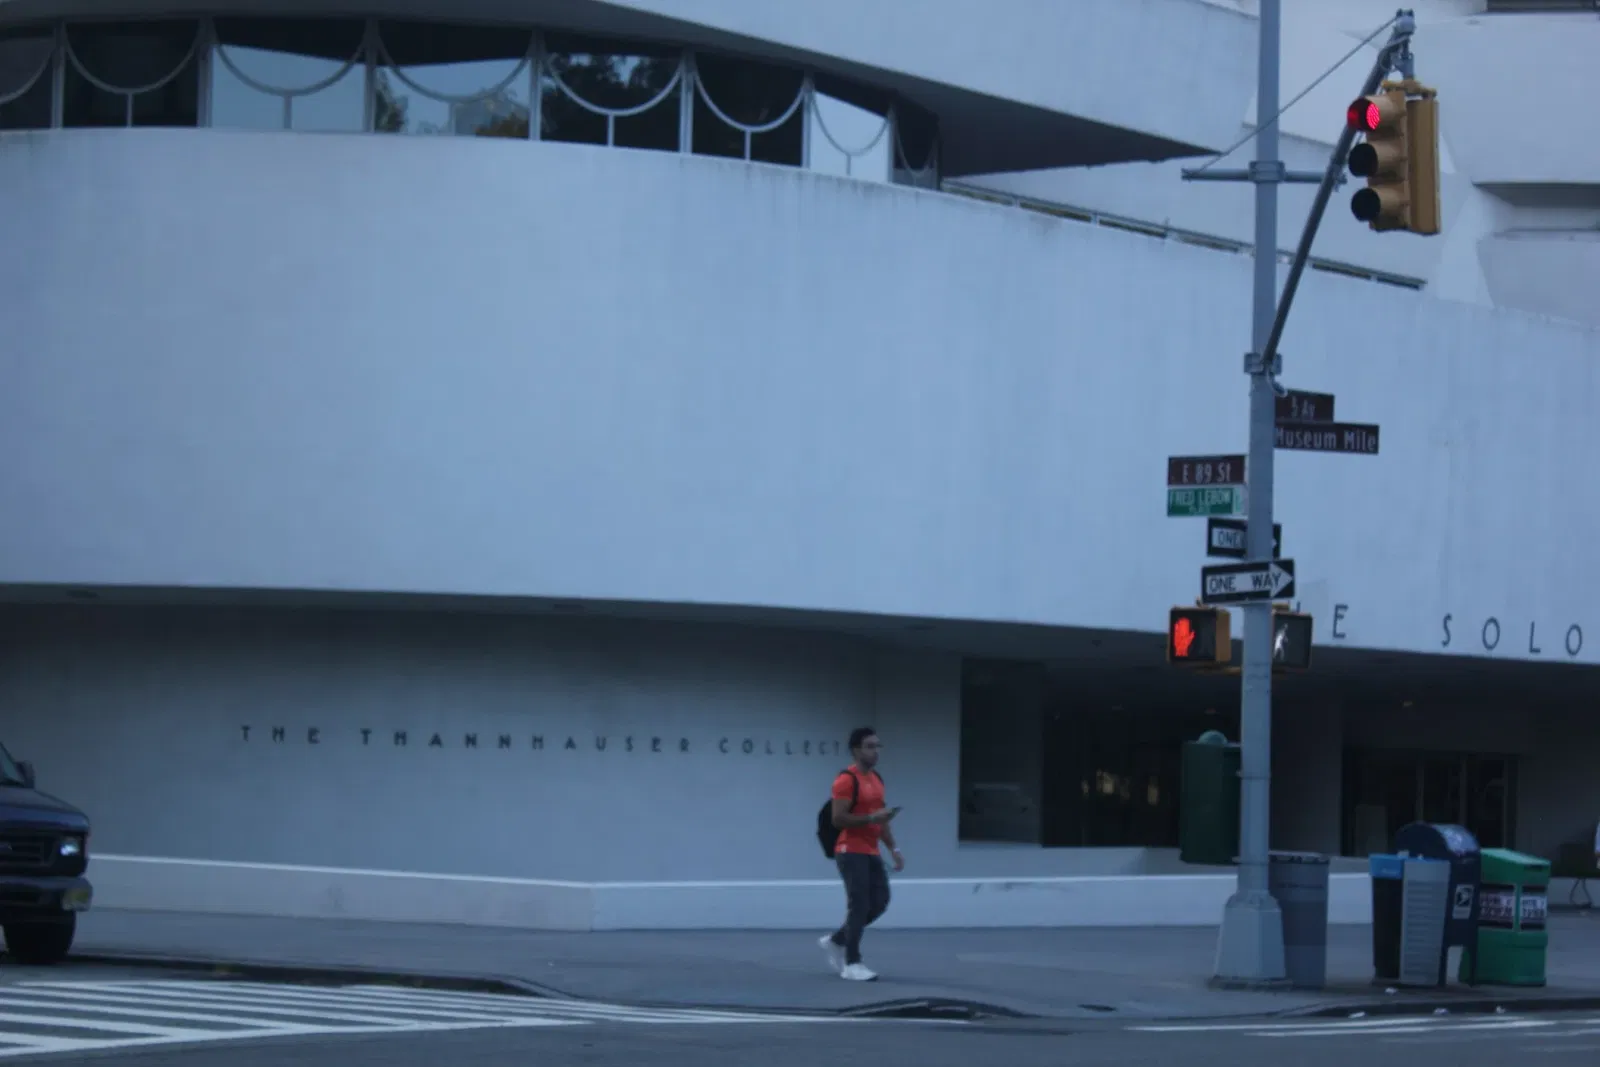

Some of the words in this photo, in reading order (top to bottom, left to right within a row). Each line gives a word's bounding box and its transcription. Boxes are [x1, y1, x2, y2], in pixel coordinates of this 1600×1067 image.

[1275, 427, 1337, 449] Museum
[1343, 428, 1377, 452] Mile
[1182, 463, 1190, 484] E
[1195, 462, 1212, 484] 89
[1216, 461, 1232, 483] St
[1217, 530, 1240, 548] ONE
[1209, 576, 1237, 593] ONE
[1250, 572, 1282, 590] WAY
[240, 724, 321, 744] THE
[358, 728, 691, 753] THANNHAUSER
